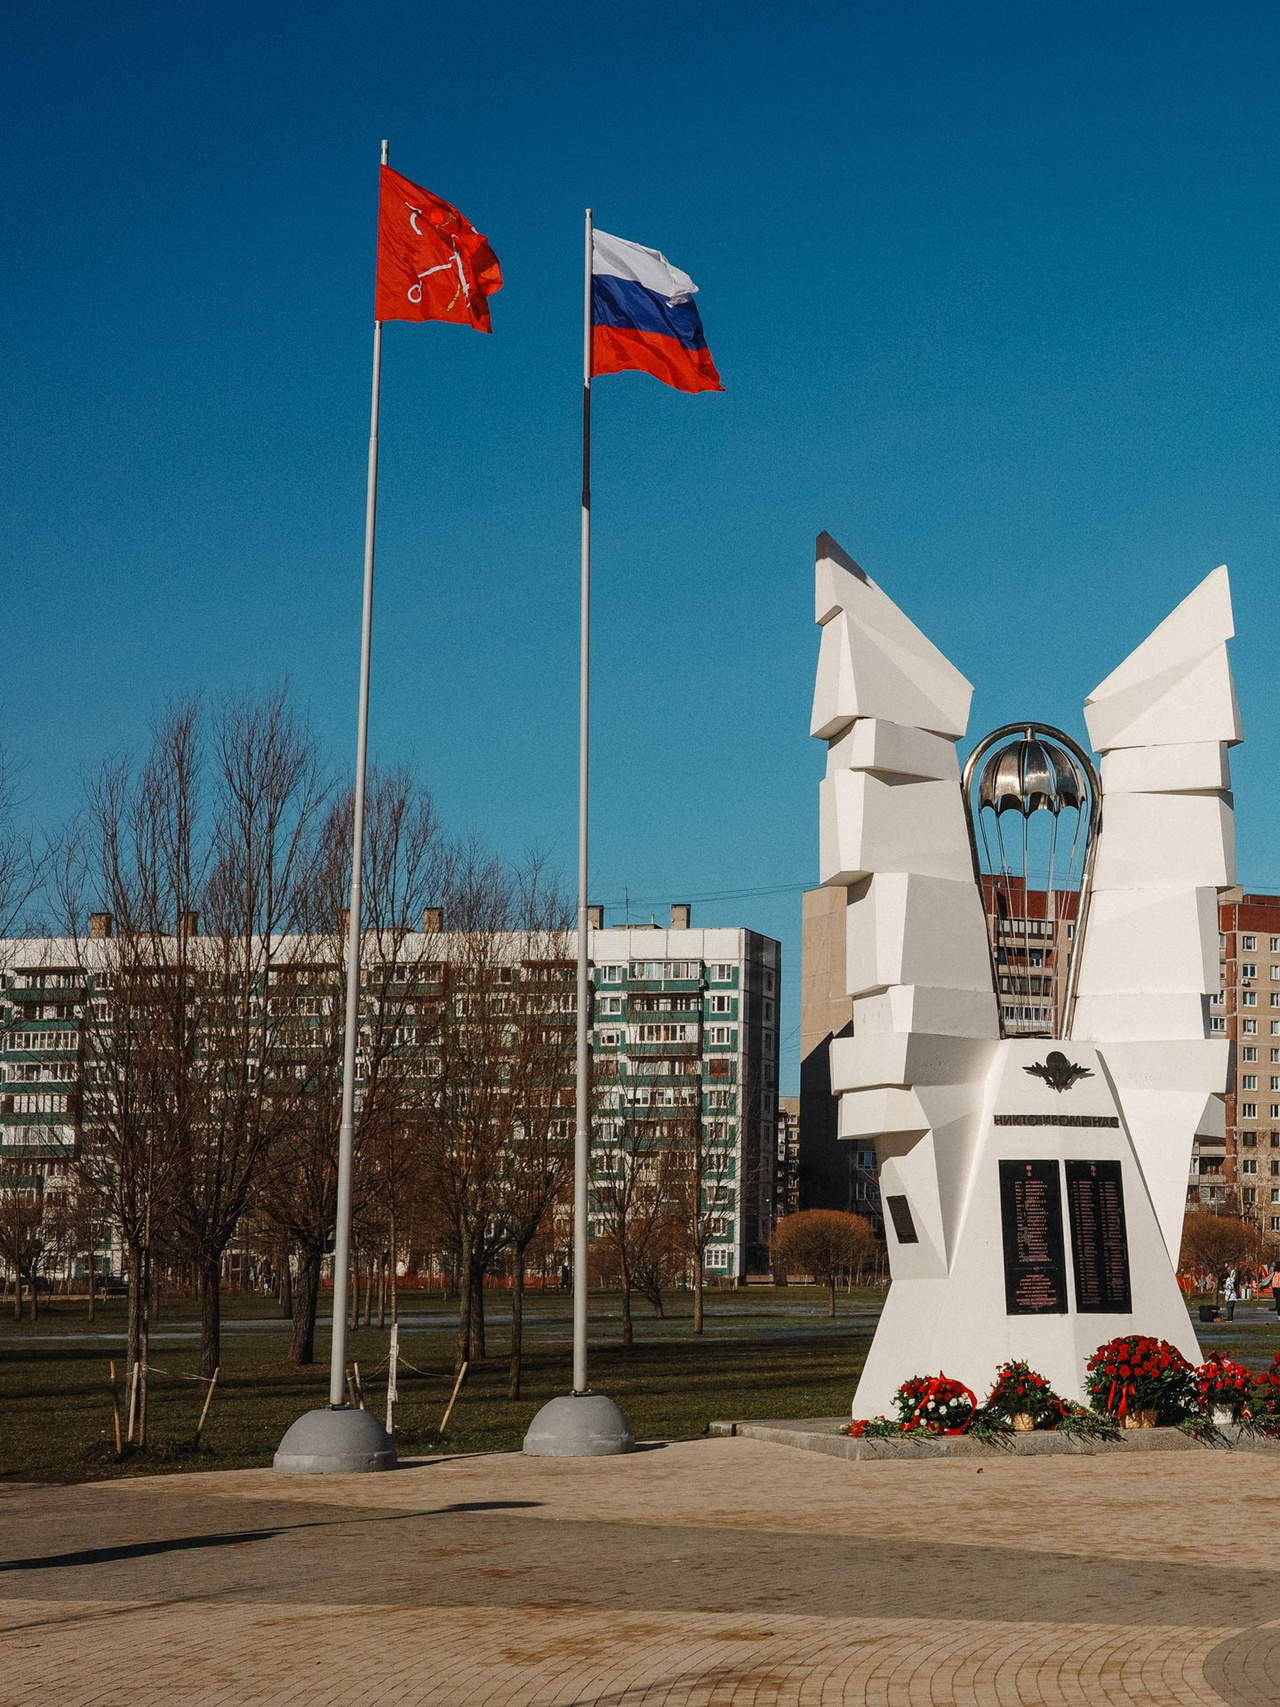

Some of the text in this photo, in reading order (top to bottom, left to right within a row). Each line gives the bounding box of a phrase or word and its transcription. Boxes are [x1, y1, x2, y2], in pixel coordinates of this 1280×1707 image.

[994, 1115, 1119, 1128] НИКТО КРОМЕ НАС
